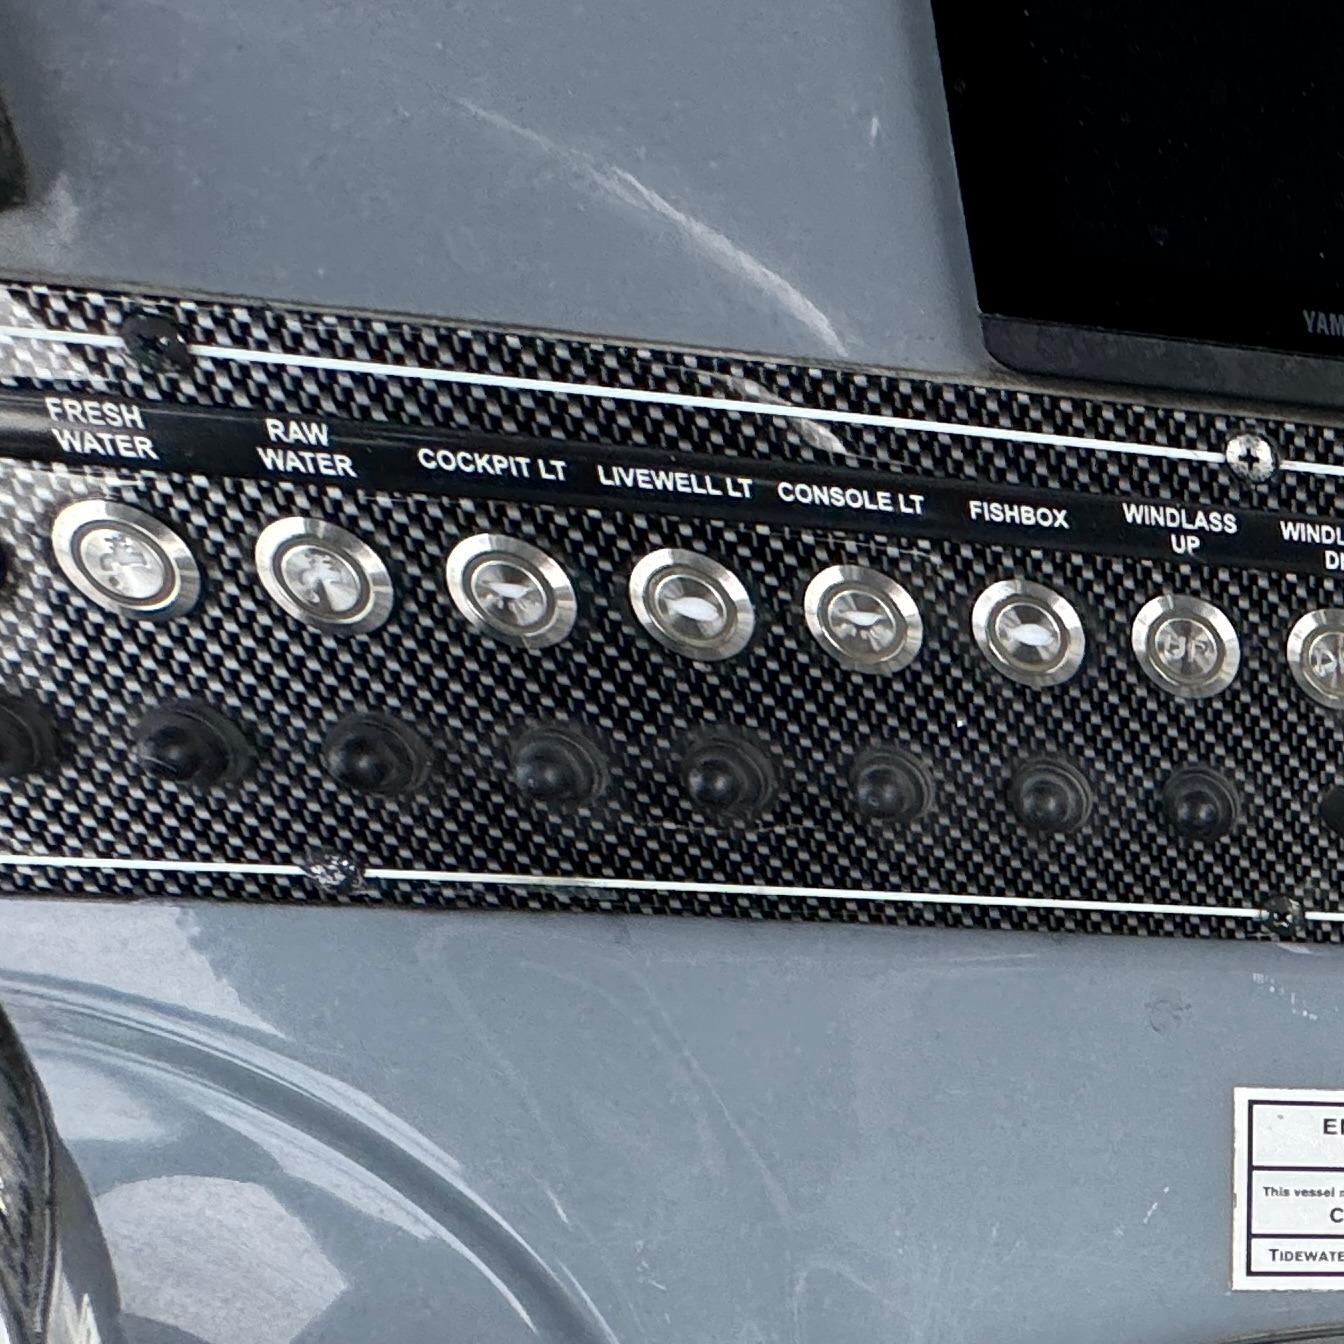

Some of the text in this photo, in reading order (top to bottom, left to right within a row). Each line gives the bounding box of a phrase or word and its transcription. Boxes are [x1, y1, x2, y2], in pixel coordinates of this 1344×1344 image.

[45, 397, 144, 431] FRESH
[51, 426, 161, 462] WATER
[265, 417, 330, 448] RAW
[256, 446, 359, 480] WATER
[416, 446, 567, 482] COCKPIT LT
[598, 463, 754, 500] LIVEWELL LT
[777, 480, 925, 516] CONSOLE LT
[969, 499, 1070, 531] FISHBOX
[1122, 503, 1239, 535] WINDLASS
[1169, 532, 1201, 555] UP
[1262, 1186, 1291, 1199] This
[1294, 1187, 1336, 1199] vessel
